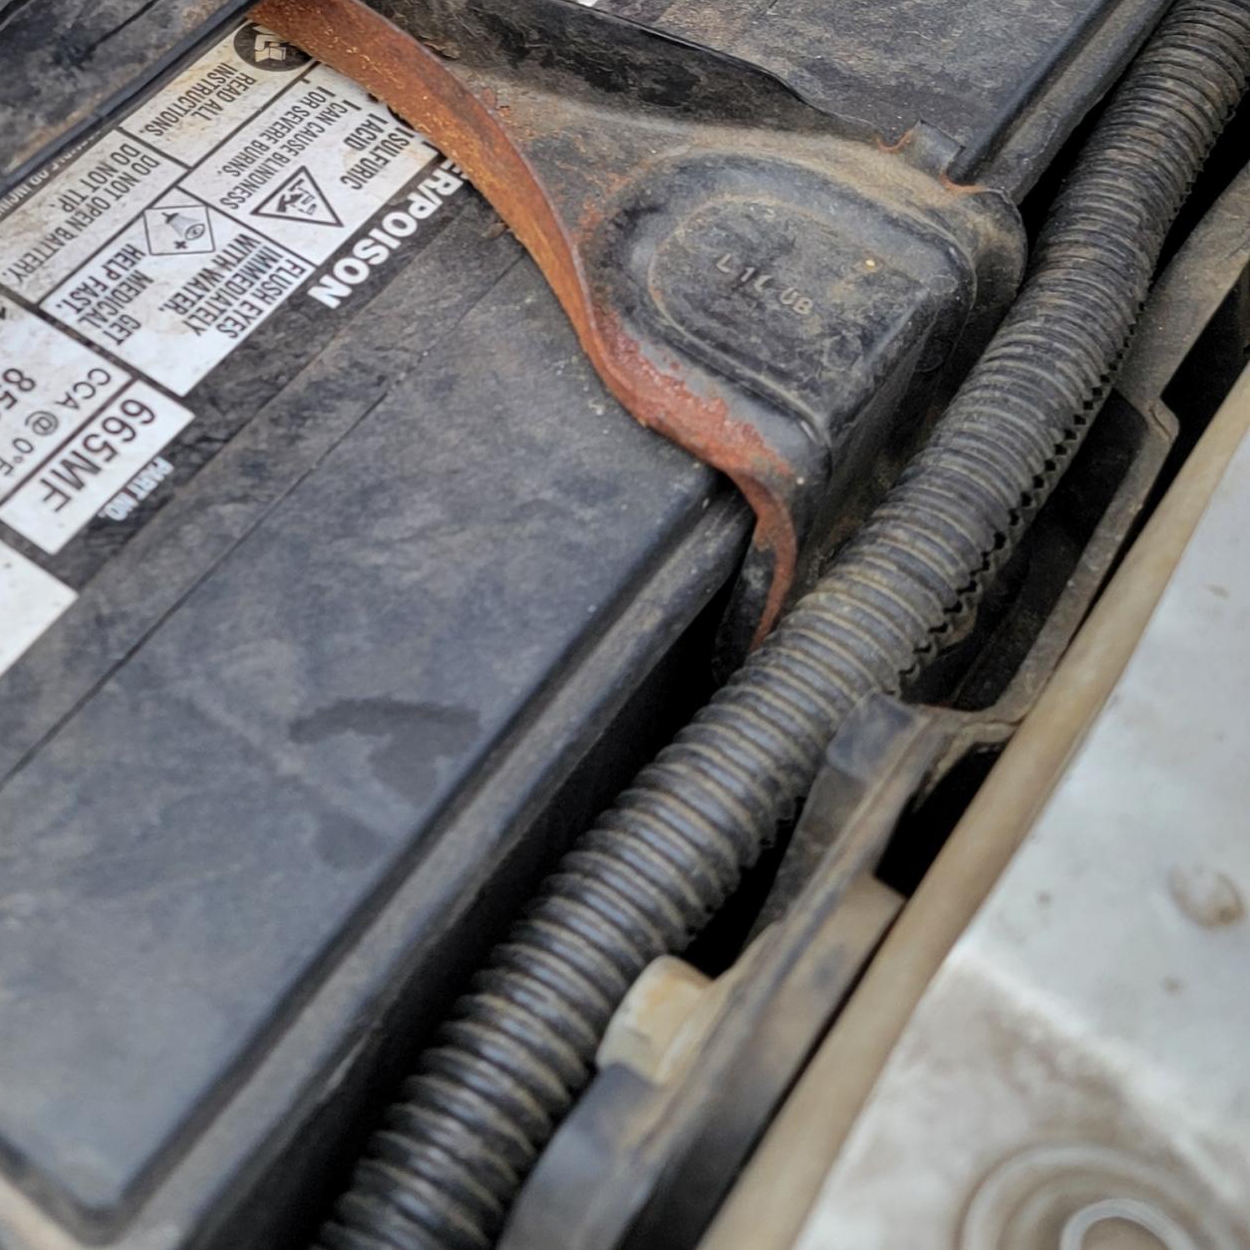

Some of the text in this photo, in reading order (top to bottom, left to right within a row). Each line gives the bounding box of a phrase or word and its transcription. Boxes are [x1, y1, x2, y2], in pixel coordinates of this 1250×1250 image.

[138, 60, 237, 139] INSTRUCTIONS.
[190, 71, 256, 123] READ ALL
[109, 142, 140, 167] DO
[216, 90, 327, 179] OR SEVERE BURNS.
[217, 100, 348, 212] CAN CAUSE BLINDNESS
[338, 132, 409, 192] SULFURIC
[342, 119, 383, 152] ACID
[48, 187, 88, 213] TIP.
[78, 161, 119, 192] NOT
[0, 153, 160, 285] DO NOT OPEN BATTERY.
[54, 243, 145, 316] HELP FAST.
[76, 268, 154, 332] MEDICAL
[157, 231, 260, 319] WITH WATER.
[181, 245, 282, 336] IMMEDIATELY
[215, 257, 306, 340] FLUSH EYES
[101, 313, 142, 346] GET
[54, 364, 113, 411] CCA
[24, 409, 58, 434] @
[39, 394, 157, 512] 665MF
[96, 455, 174, 523] PART NO.
